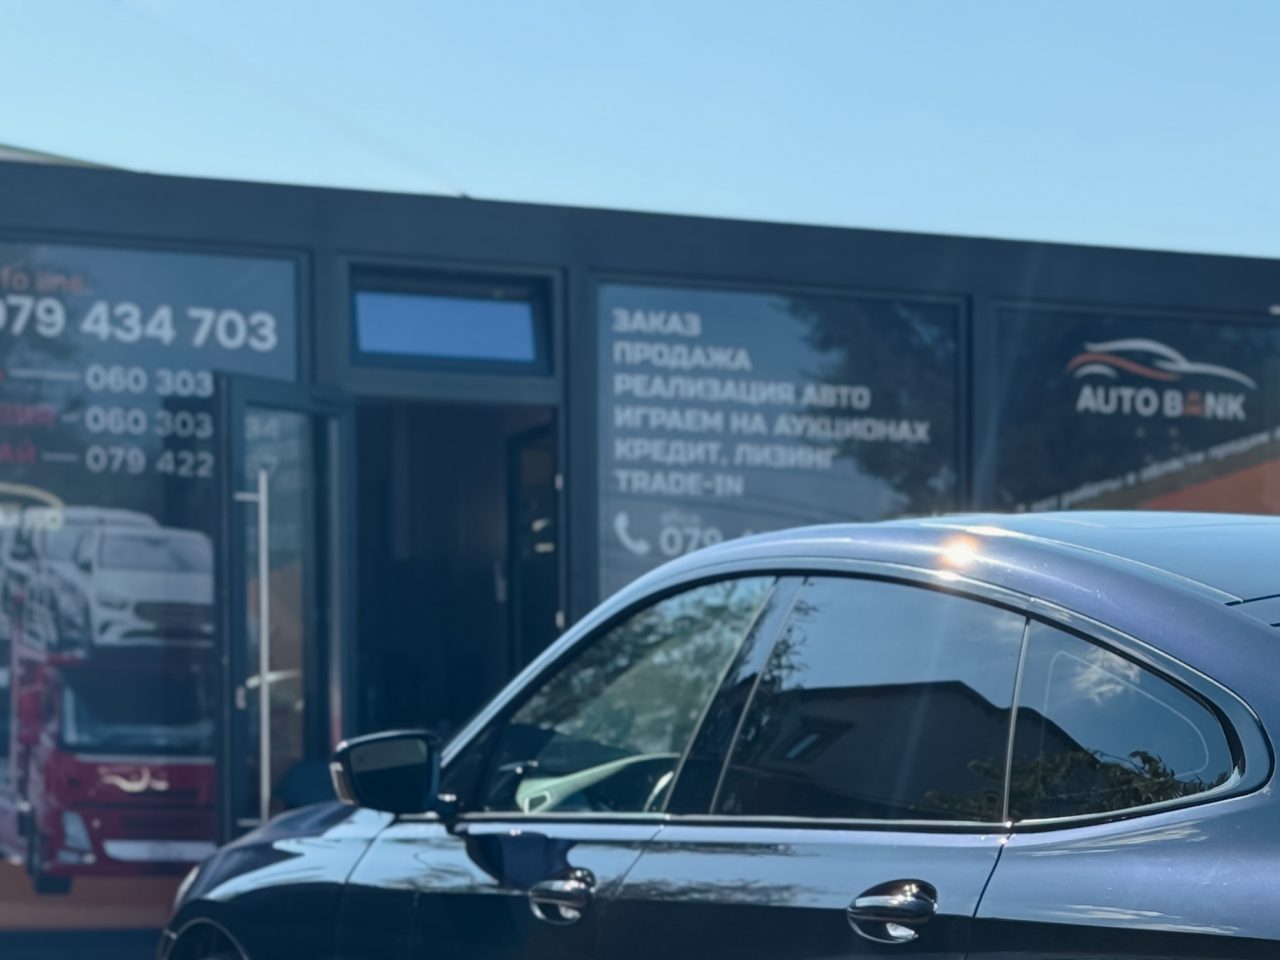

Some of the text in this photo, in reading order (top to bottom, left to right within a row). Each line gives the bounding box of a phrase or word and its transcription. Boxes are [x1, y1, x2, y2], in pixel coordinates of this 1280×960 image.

[0, 294, 278, 351] 79 434 703
[612, 308, 701, 336] ЗАКАЗ
[613, 341, 752, 371] ПРОДАЖА
[85, 364, 214, 397] 060 303
[613, 374, 871, 410] РЕАЛИЗАЦИЯ АВТО
[1076, 384, 1158, 417] AUTO
[85, 406, 147, 435] 060
[155, 411, 213, 438] 303
[614, 406, 930, 443] ИГРАЕМ НА АУКЦИОНАХ
[85, 446, 146, 474] 079
[156, 450, 214, 477] 422
[734, 443, 838, 469] ЛИЗИНГ
[616, 469, 744, 496] TRADE-IN
